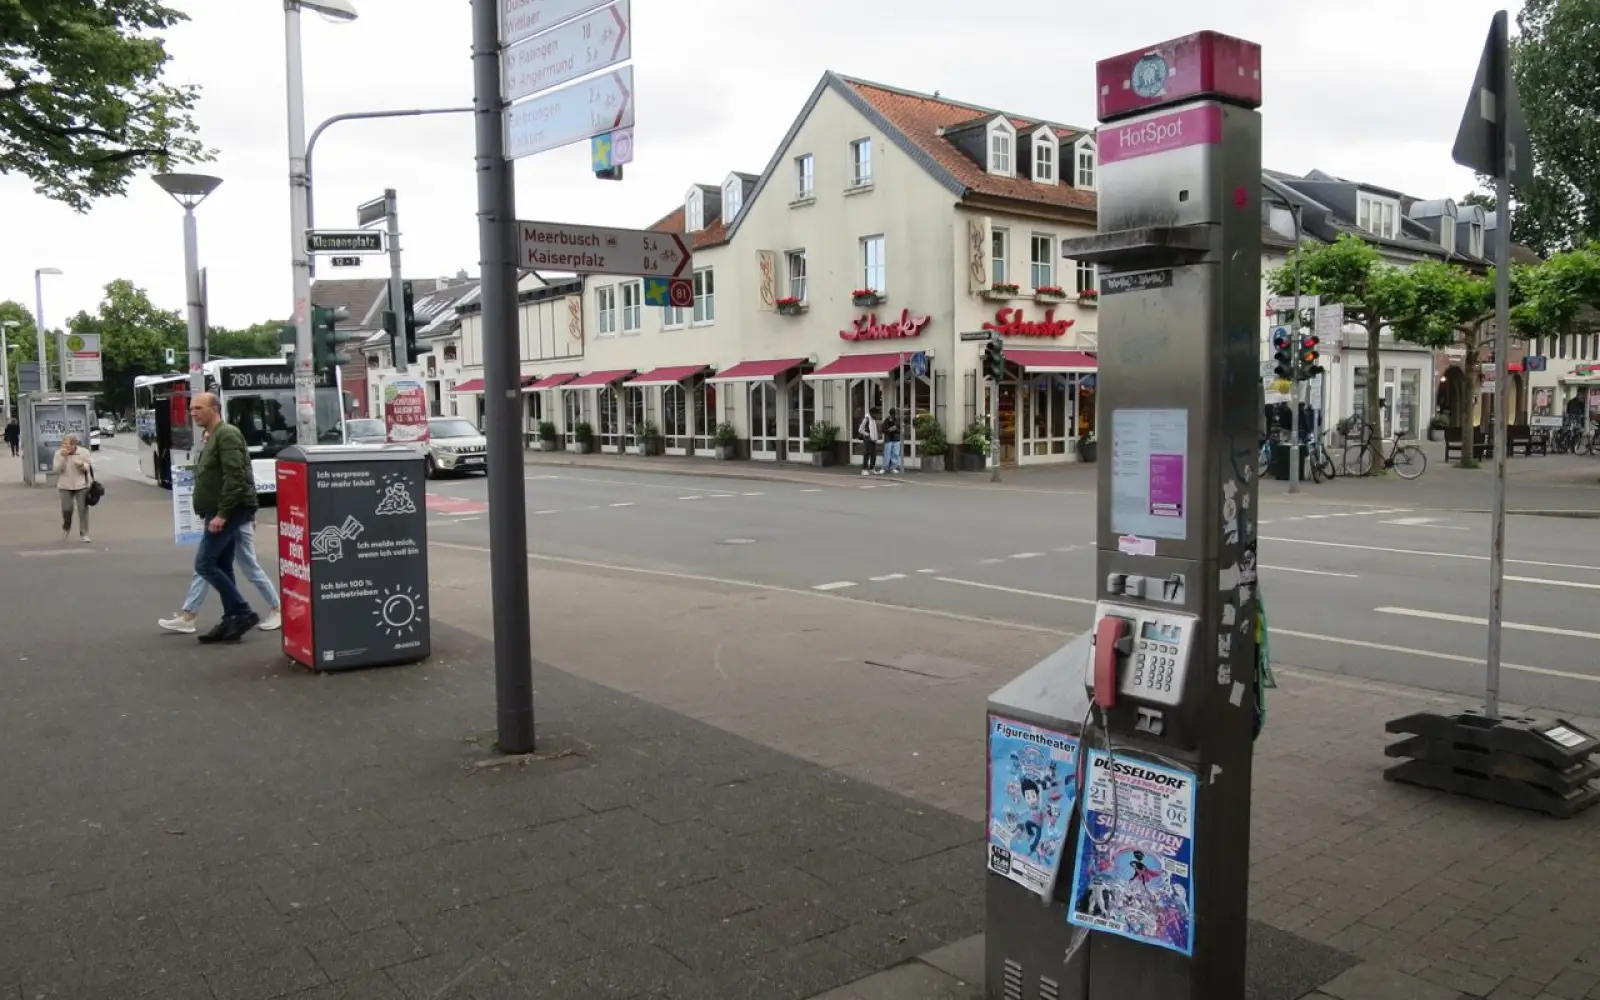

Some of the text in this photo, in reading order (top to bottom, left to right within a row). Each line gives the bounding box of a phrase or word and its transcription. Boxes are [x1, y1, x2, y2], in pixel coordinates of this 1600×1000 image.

[582, 23, 591, 40] 10
[1120, 115, 1182, 147] HotSpot
[524, 228, 600, 247] Meerbusch
[528, 248, 605, 269] Kaiserpfalz
[676, 287, 688, 299] 81
[230, 373, 294, 387] 760 Abfahrt
[316, 470, 370, 480] Ich verpresse
[316, 479, 376, 489] für mehr Inhalt
[357, 541, 370, 550] Ich
[371, 540, 394, 548] melde
[358, 551, 379, 559] wenn
[320, 582, 334, 590] Ich
[335, 581, 348, 589] bin
[350, 579, 364, 588] 100
[320, 589, 379, 600] solarbetrieben
[996, 722, 1076, 753] Figurentheater
[1094, 757, 1187, 790] DÜSSELDORF
[1089, 786, 1106, 801] 21
[1166, 808, 1188, 824] 06
[1094, 813, 1184, 850] SUPERHELDEN
